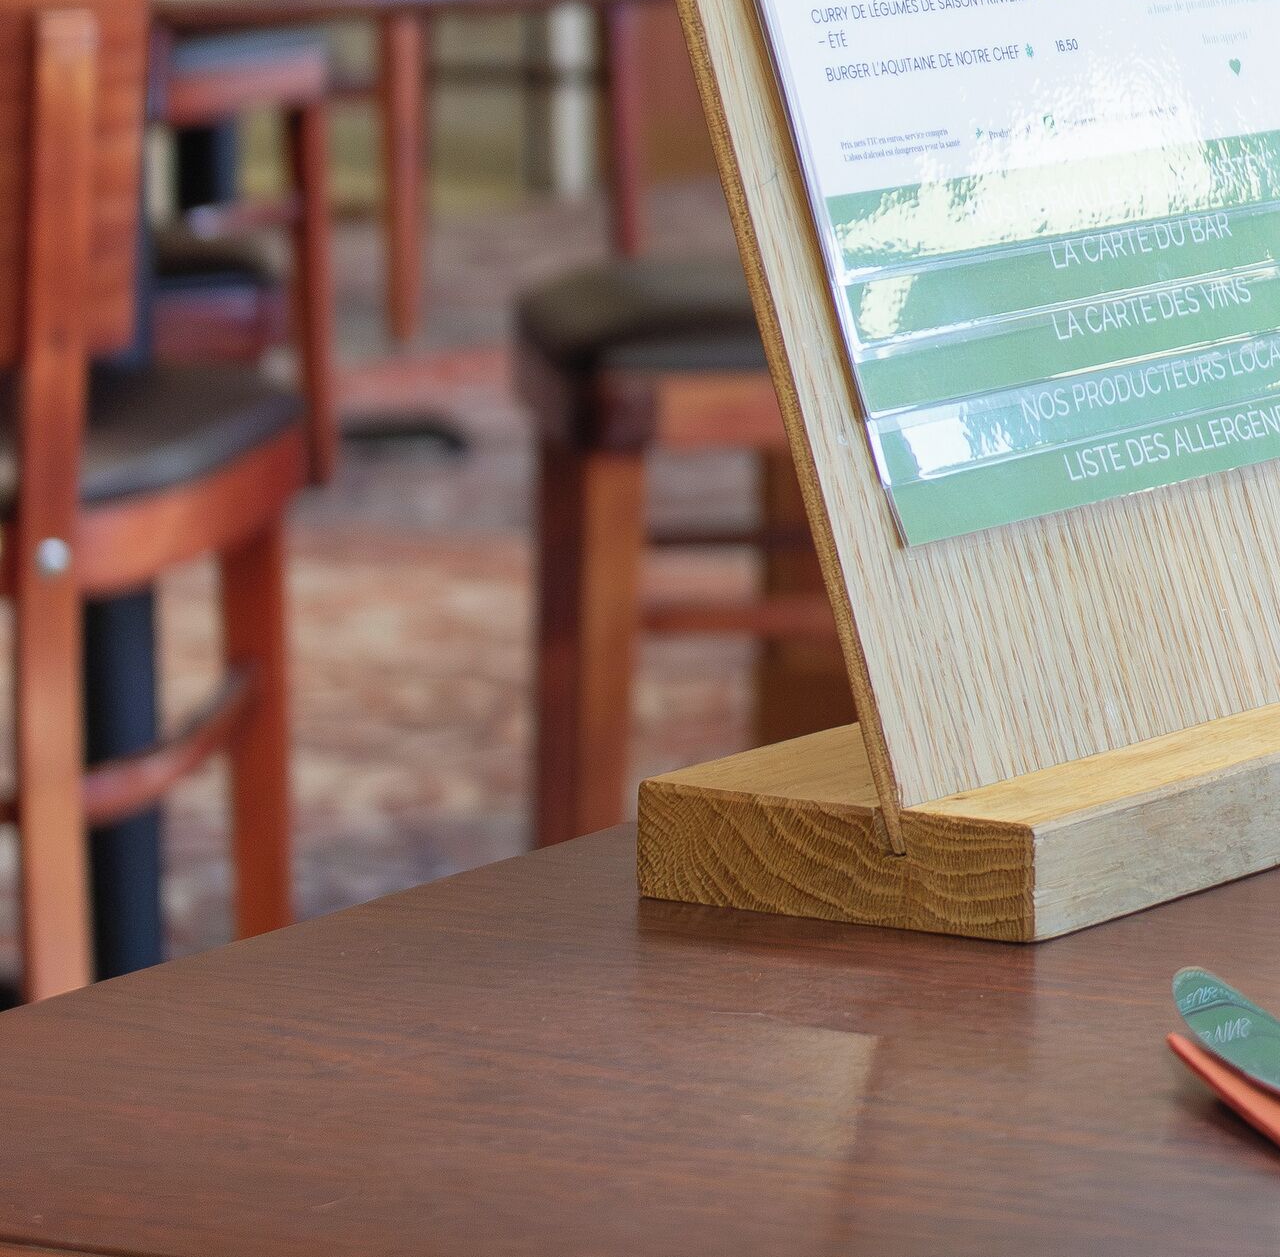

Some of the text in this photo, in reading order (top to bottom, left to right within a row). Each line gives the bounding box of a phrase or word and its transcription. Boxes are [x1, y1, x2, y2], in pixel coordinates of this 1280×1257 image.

[811, 6, 848, 24] CURRY
[850, 4, 867, 20] DE
[825, 38, 1079, 82] BURGER L'AQUITAINE DE NOTRE CHEF 16.50
[1050, 212, 1232, 269] LA CARTE DU BAR
[1051, 277, 1251, 340] LA CARTE DES VINS
[1020, 387, 1070, 424] NOS
[1072, 358, 1226, 412] PRODUCTEURS
[1063, 442, 1126, 481] LISTE
[1125, 432, 1170, 467] DES
